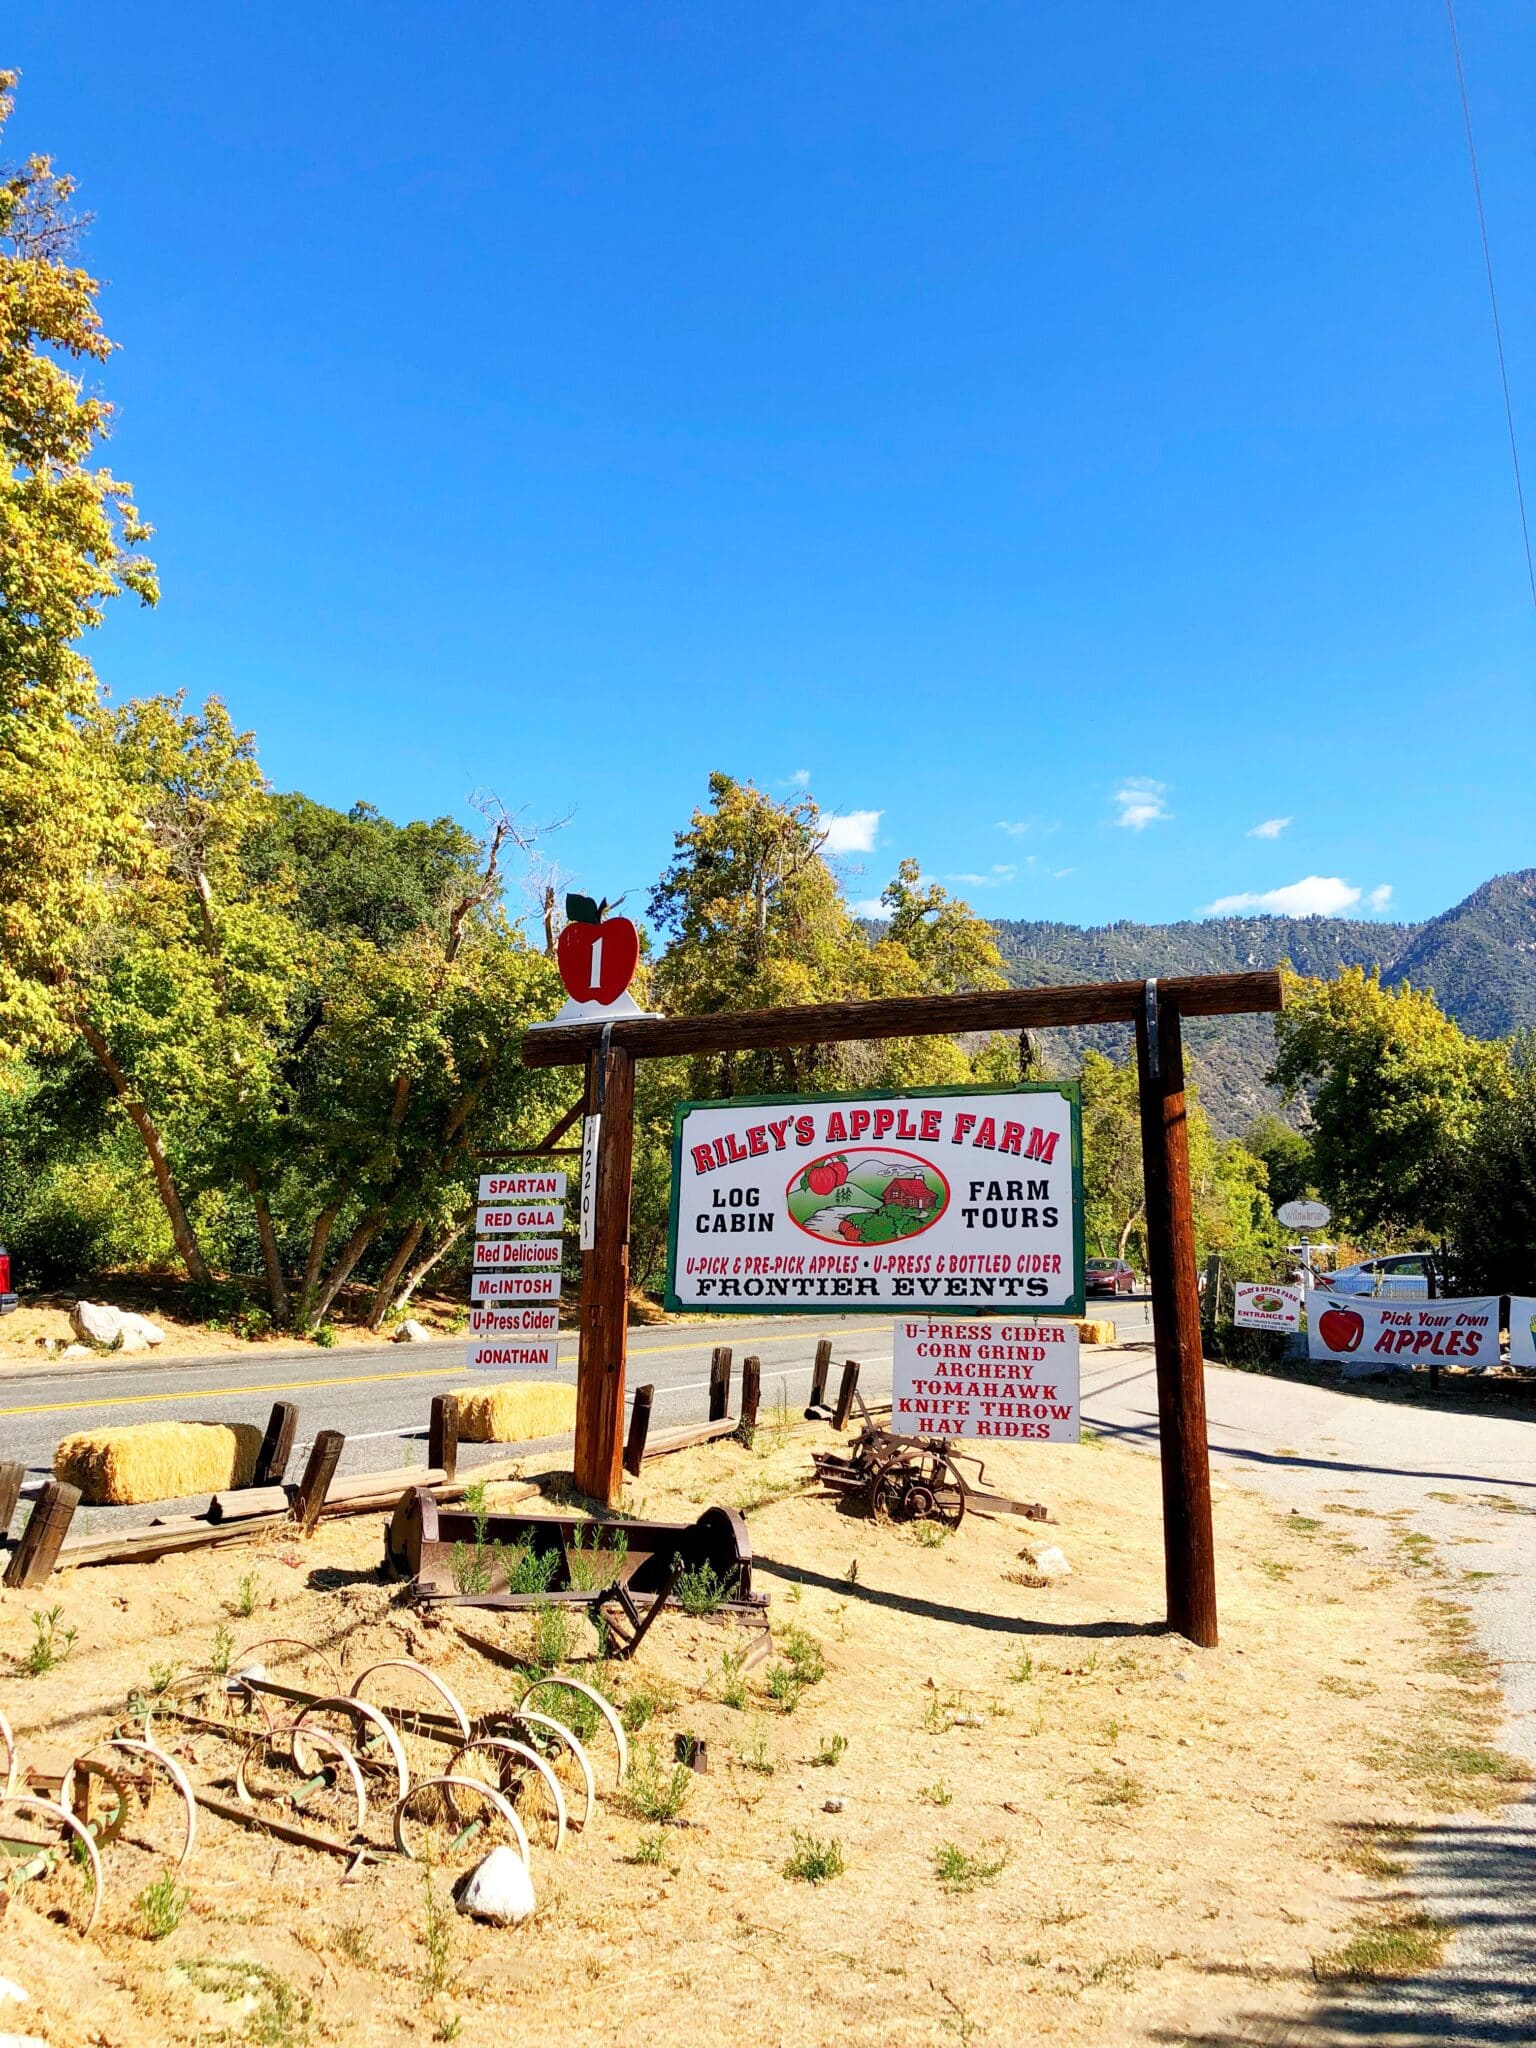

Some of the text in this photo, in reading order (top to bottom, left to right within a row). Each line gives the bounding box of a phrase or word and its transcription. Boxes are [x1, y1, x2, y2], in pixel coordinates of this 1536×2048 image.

[589, 936, 603, 989] 1
[690, 1109, 1060, 1175] RILEY'S APPLE FARM
[489, 1179, 556, 1193] SPARTAN
[969, 1180, 1049, 1201] FARM
[713, 1188, 760, 1207] LOG
[485, 1212, 554, 1226] RED GALA
[696, 1213, 774, 1233] CABIN
[962, 1207, 1058, 1228] TOURS
[477, 1243, 558, 1262] Red Delicious
[686, 1255, 1061, 1275] U-PICK & PRE-PICK APPLES U-PRESS & BOTTLED CIDER
[479, 1280, 552, 1294] McINTOSH
[696, 1277, 1048, 1297] FRONTIER EVENTS
[1260, 1286, 1280, 1294] APPLE
[1281, 1290, 1298, 1302] FARM
[473, 1311, 555, 1329] U-Press Cider
[1238, 1311, 1283, 1320] ENTRANCE
[1380, 1311, 1489, 1326] Pick Your Own
[905, 1324, 1065, 1342] U-PRESS CIDER
[1374, 1328, 1482, 1356] APPLES
[475, 1350, 548, 1364] JONATHAN
[917, 1343, 1045, 1361] CORN GRIND
[934, 1363, 1033, 1379] ARCHERY
[912, 1380, 1057, 1400] TOMAHAWK
[898, 1398, 1072, 1420] KNIFE THROW
[919, 1418, 1050, 1438] HAY RIDES
